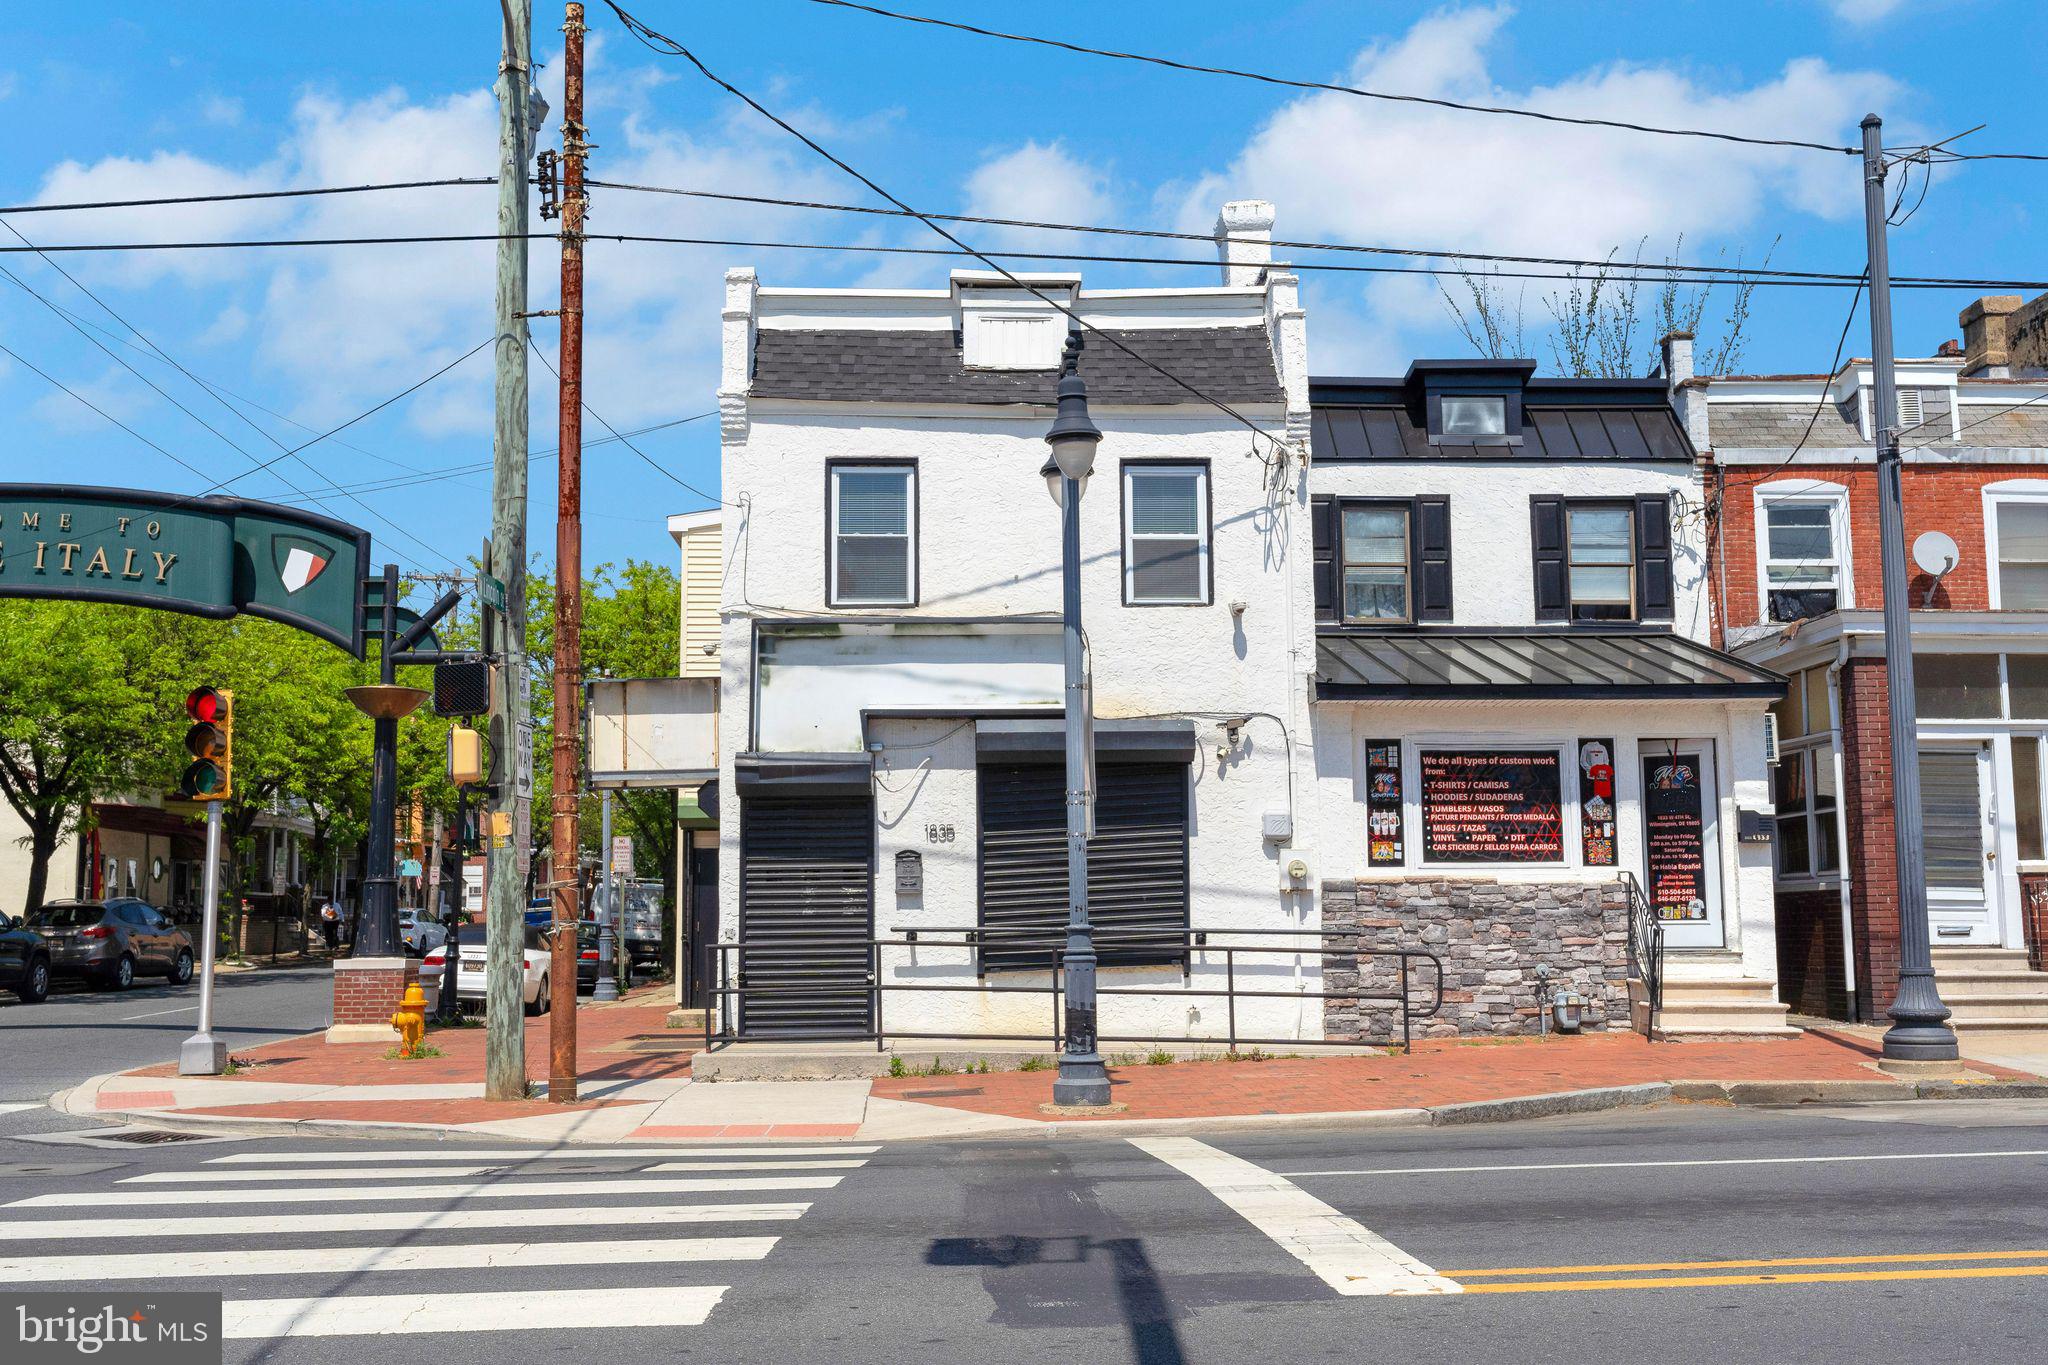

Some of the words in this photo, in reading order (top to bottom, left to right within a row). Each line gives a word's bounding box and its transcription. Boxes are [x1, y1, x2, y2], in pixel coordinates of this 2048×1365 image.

[0, 511, 72, 528] ME
[118, 517, 161, 536] TO
[33, 541, 178, 580] ITALY
[518, 730, 532, 749] ONE
[518, 750, 532, 770] WAY
[1422, 757, 1438, 765] We
[1439, 757, 1450, 765] do
[1451, 757, 1462, 765] all
[1463, 757, 1487, 766] types
[1489, 757, 1498, 765] of
[1500, 757, 1531, 765] custom
[1532, 757, 1555, 765] work
[1431, 793, 1467, 801] HOODIES
[1475, 793, 1524, 801] SUDADERAS
[924, 823, 955, 842] 1835
